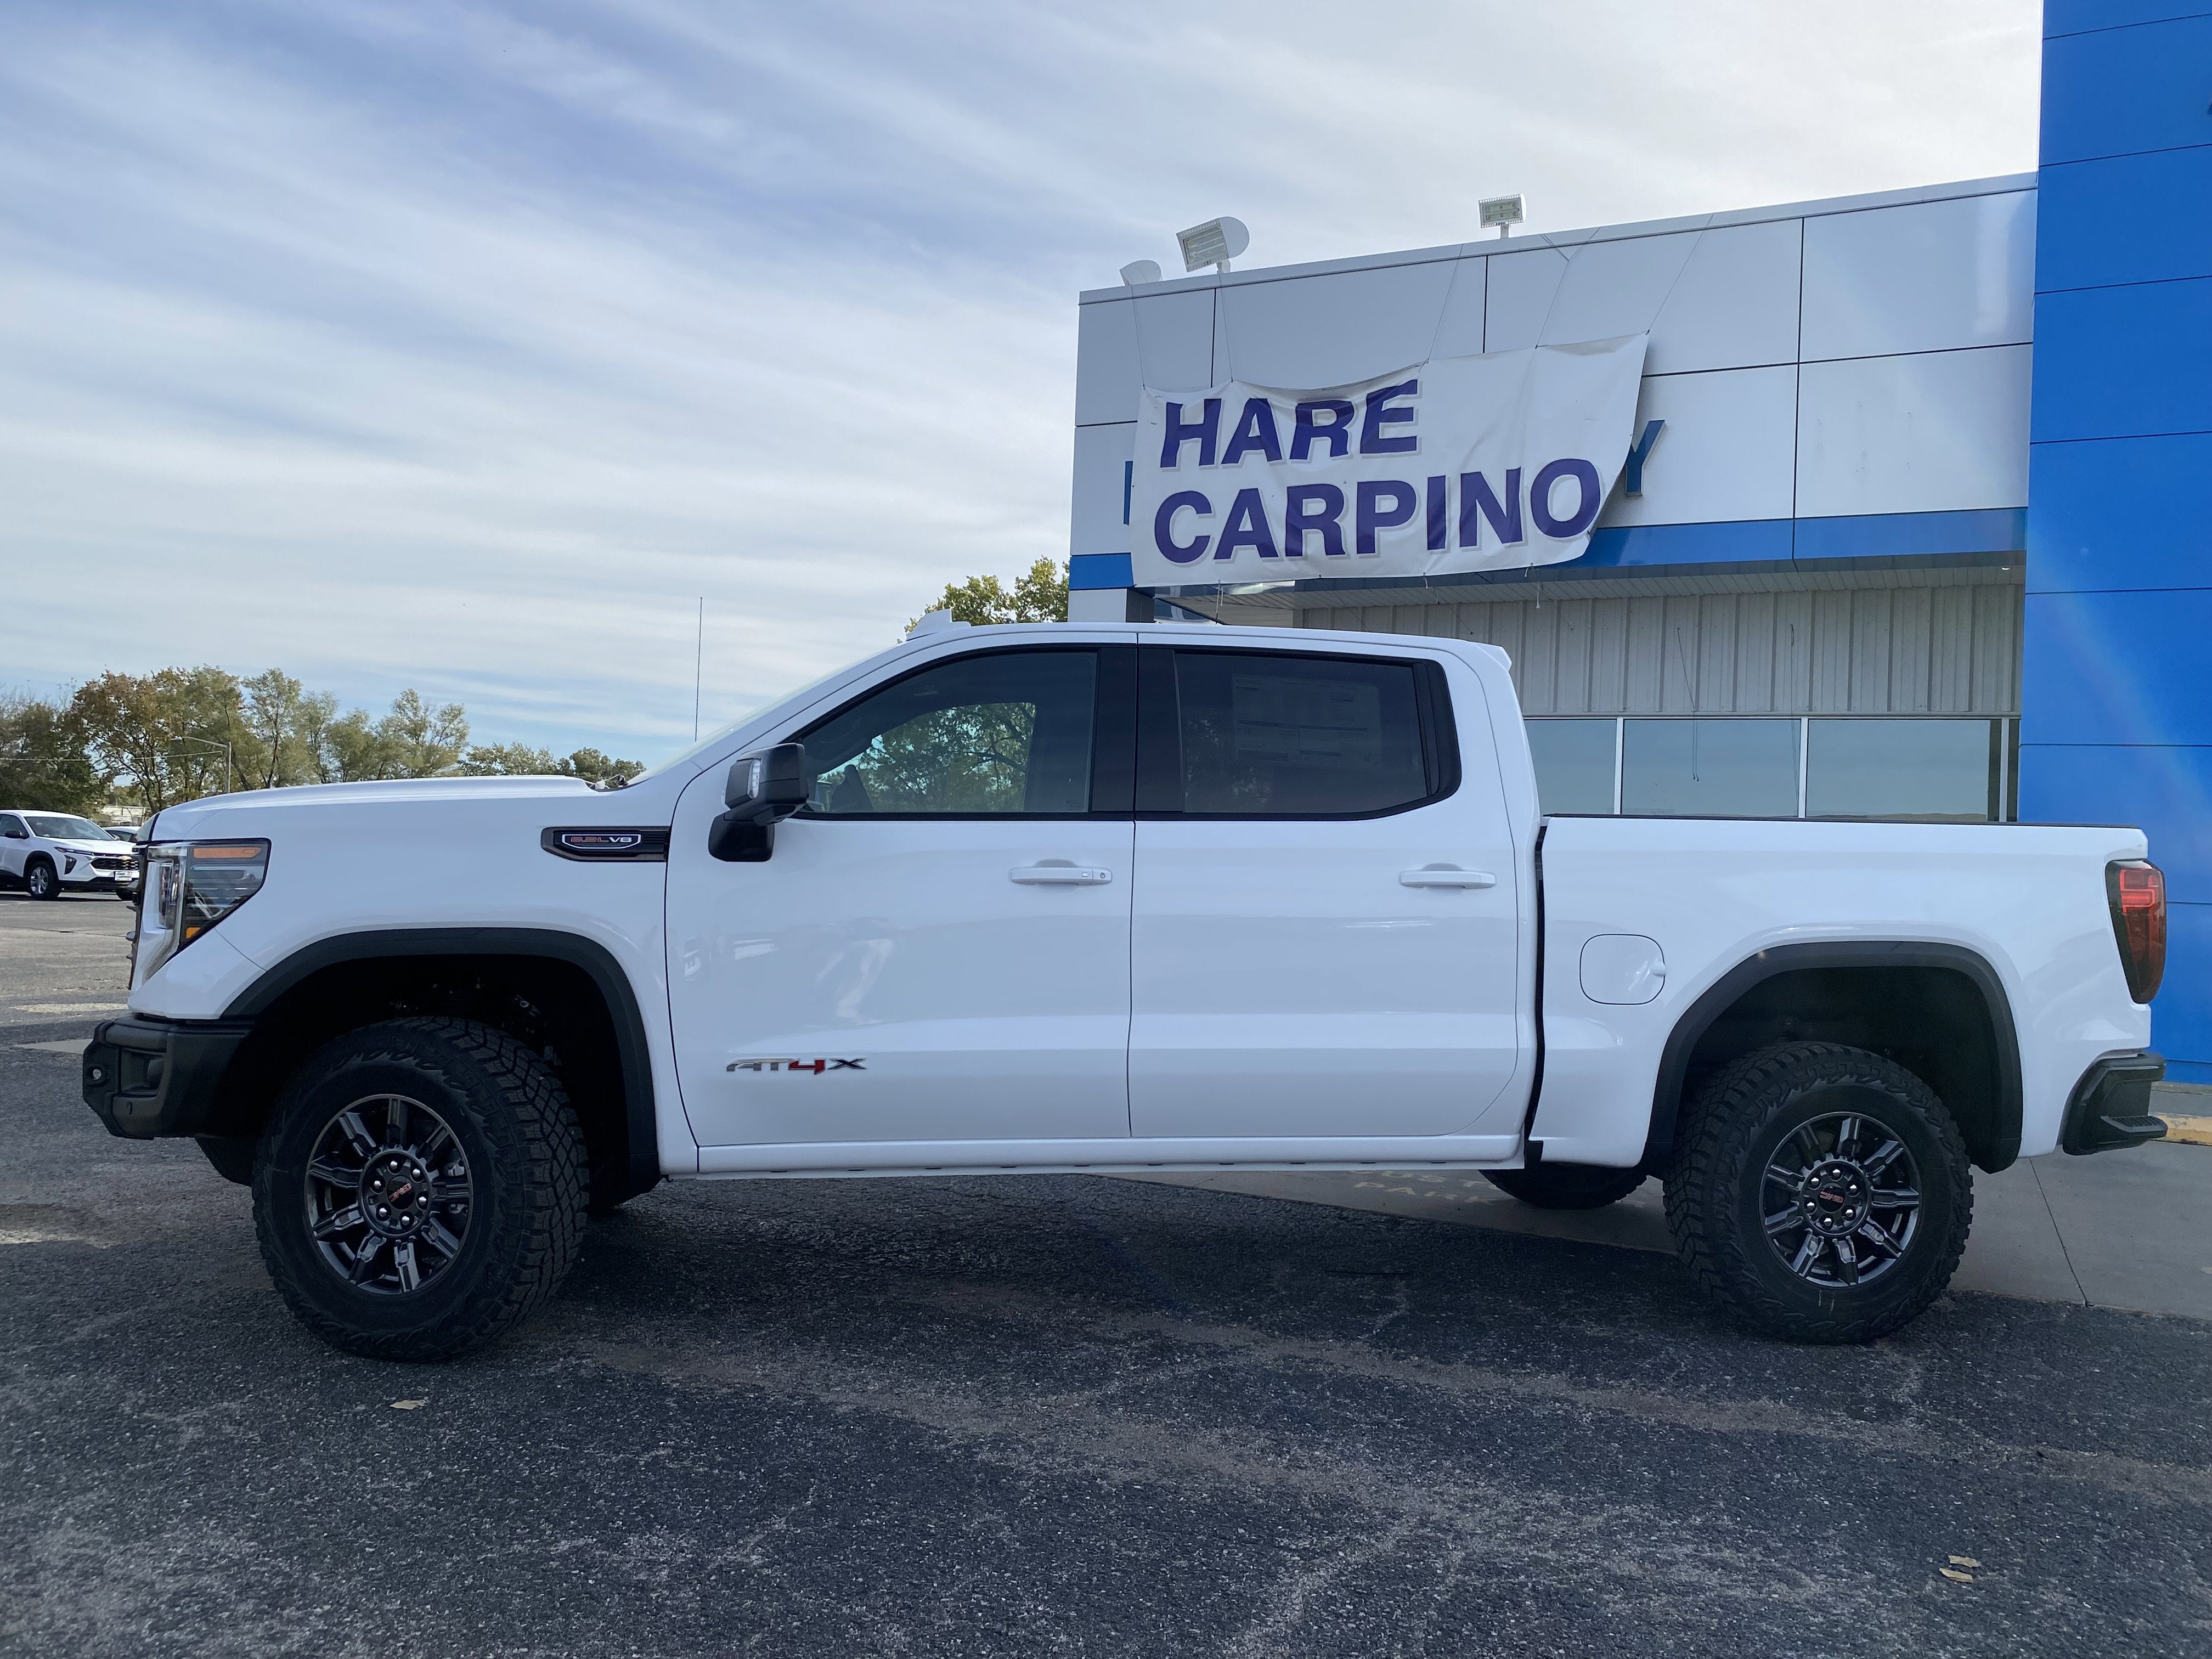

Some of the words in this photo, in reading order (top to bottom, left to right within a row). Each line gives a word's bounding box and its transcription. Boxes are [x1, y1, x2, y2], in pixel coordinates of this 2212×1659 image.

[1160, 379, 1418, 468] HARE
[1154, 458, 1601, 563] CARPINO
[726, 1058, 867, 1075] AT4X
